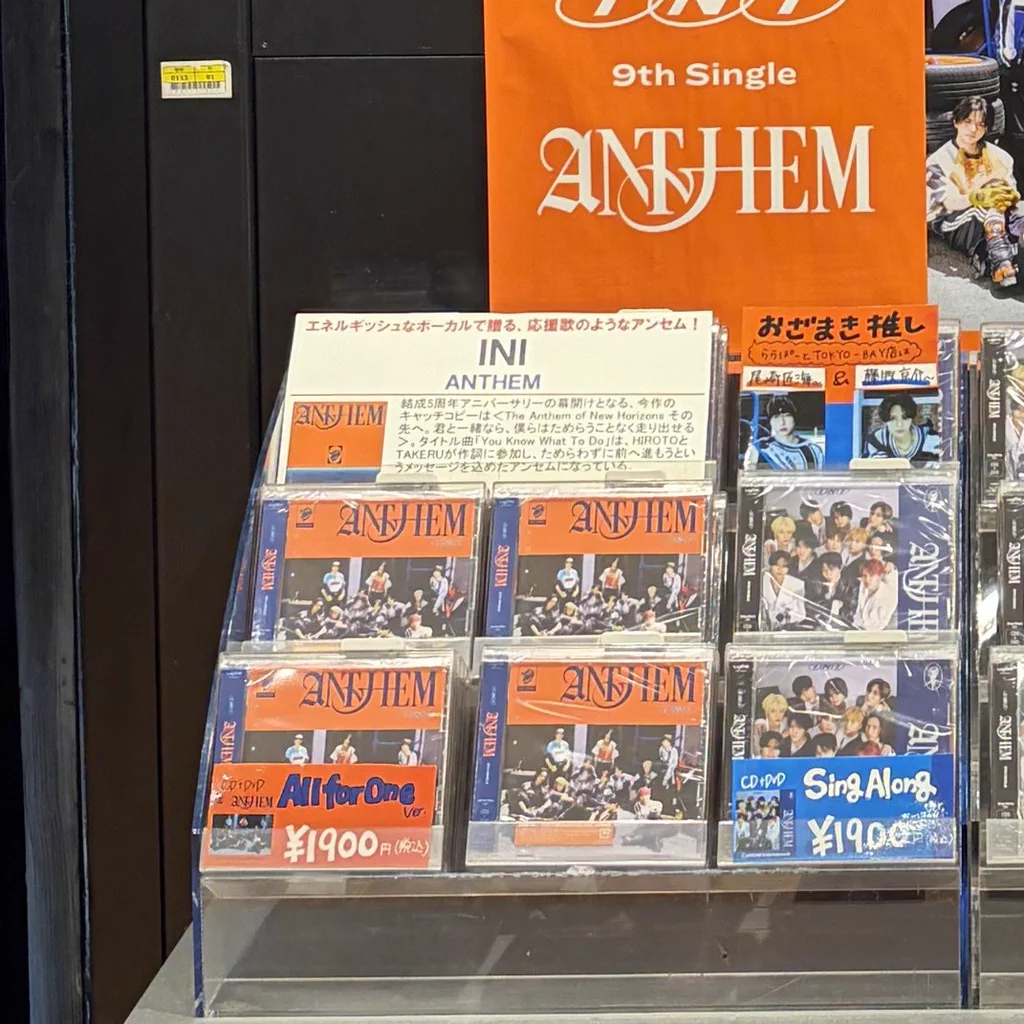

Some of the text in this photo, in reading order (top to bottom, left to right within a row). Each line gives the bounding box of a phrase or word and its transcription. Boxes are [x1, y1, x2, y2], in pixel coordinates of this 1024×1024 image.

[612, 61, 797, 90] 9th Single
[537, 124, 876, 234] ANTHEM
[757, 310, 926, 341] おざまき推し
[478, 339, 527, 366] INI
[445, 374, 541, 390] ANTHEM
[832, 370, 849, 387] &
[295, 404, 384, 430] ANTHEM
[530, 411, 571, 420] Anthem
[575, 411, 587, 420] of
[590, 411, 613, 420] New
[617, 411, 664, 420] Horizons
[669, 410, 693, 421] その
[506, 436, 535, 446] Know
[539, 436, 566, 446] What
[571, 436, 585, 446] To
[338, 502, 468, 543] ANTHEM
[569, 499, 699, 541] ANTHEM
[300, 670, 436, 715] ANTHEM
[563, 665, 697, 709] ANTHEM
[803, 767, 938, 803] Sing Along
[283, 824, 378, 863] ¥1900
